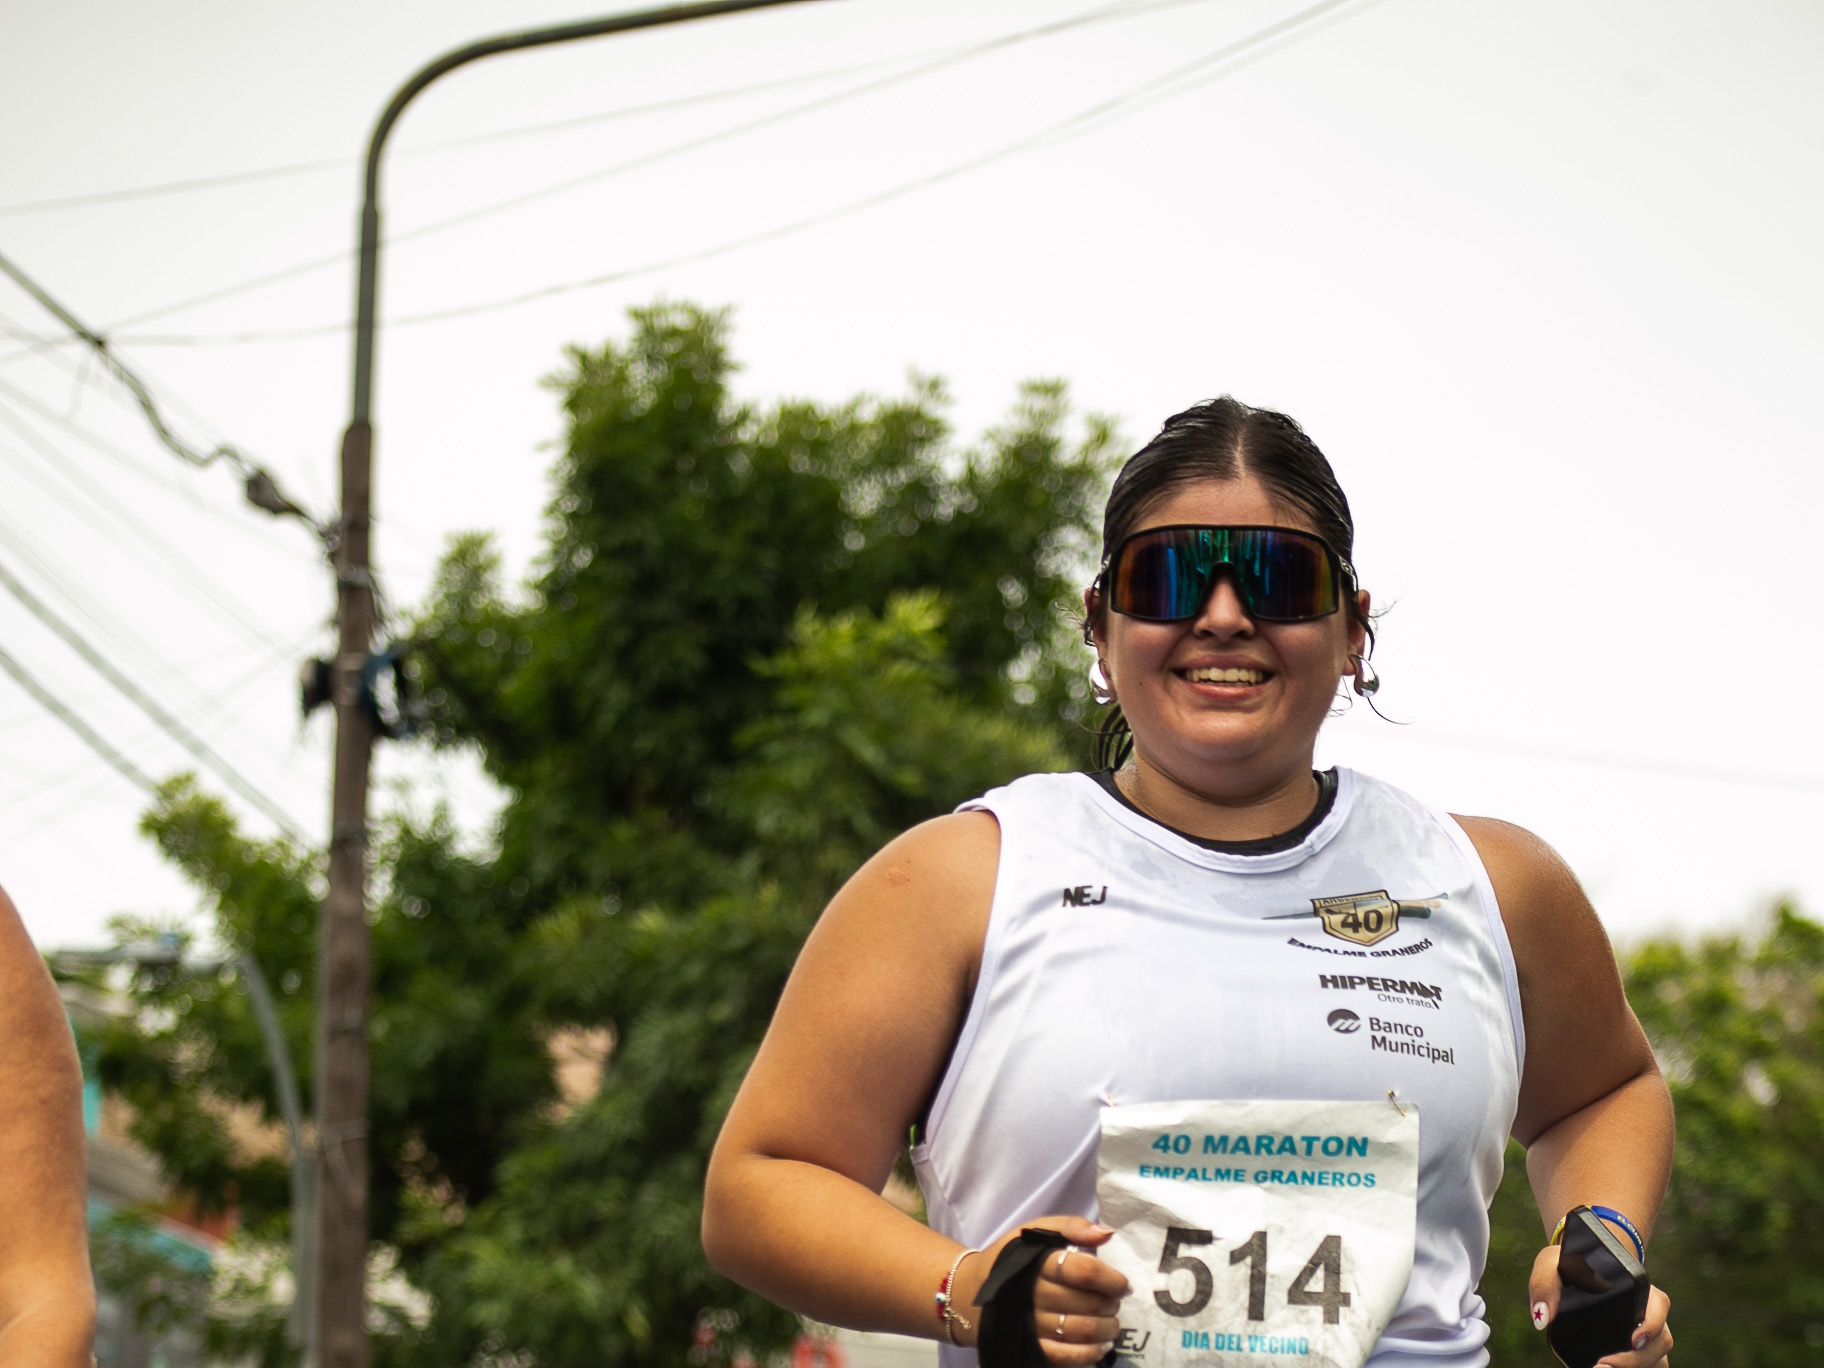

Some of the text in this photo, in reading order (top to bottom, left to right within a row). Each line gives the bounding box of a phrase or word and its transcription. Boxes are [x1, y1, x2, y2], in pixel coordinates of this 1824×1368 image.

[1062, 885, 1108, 907] NEJ
[1341, 909, 1384, 934] 40
[1370, 938, 1433, 957] GRANEROS
[1377, 993, 1404, 1004] Otro
[1369, 1017, 1424, 1038] Banco
[1371, 1035, 1455, 1065] Municipal
[1152, 1133, 1369, 1157] 40 MARATON
[1138, 1165, 1377, 1188] EMPALME GRANEROS
[1153, 1226, 1351, 1325] 514
[1114, 1328, 1151, 1352] EJ
[1182, 1330, 1309, 1356] DIA DEL VECINO
